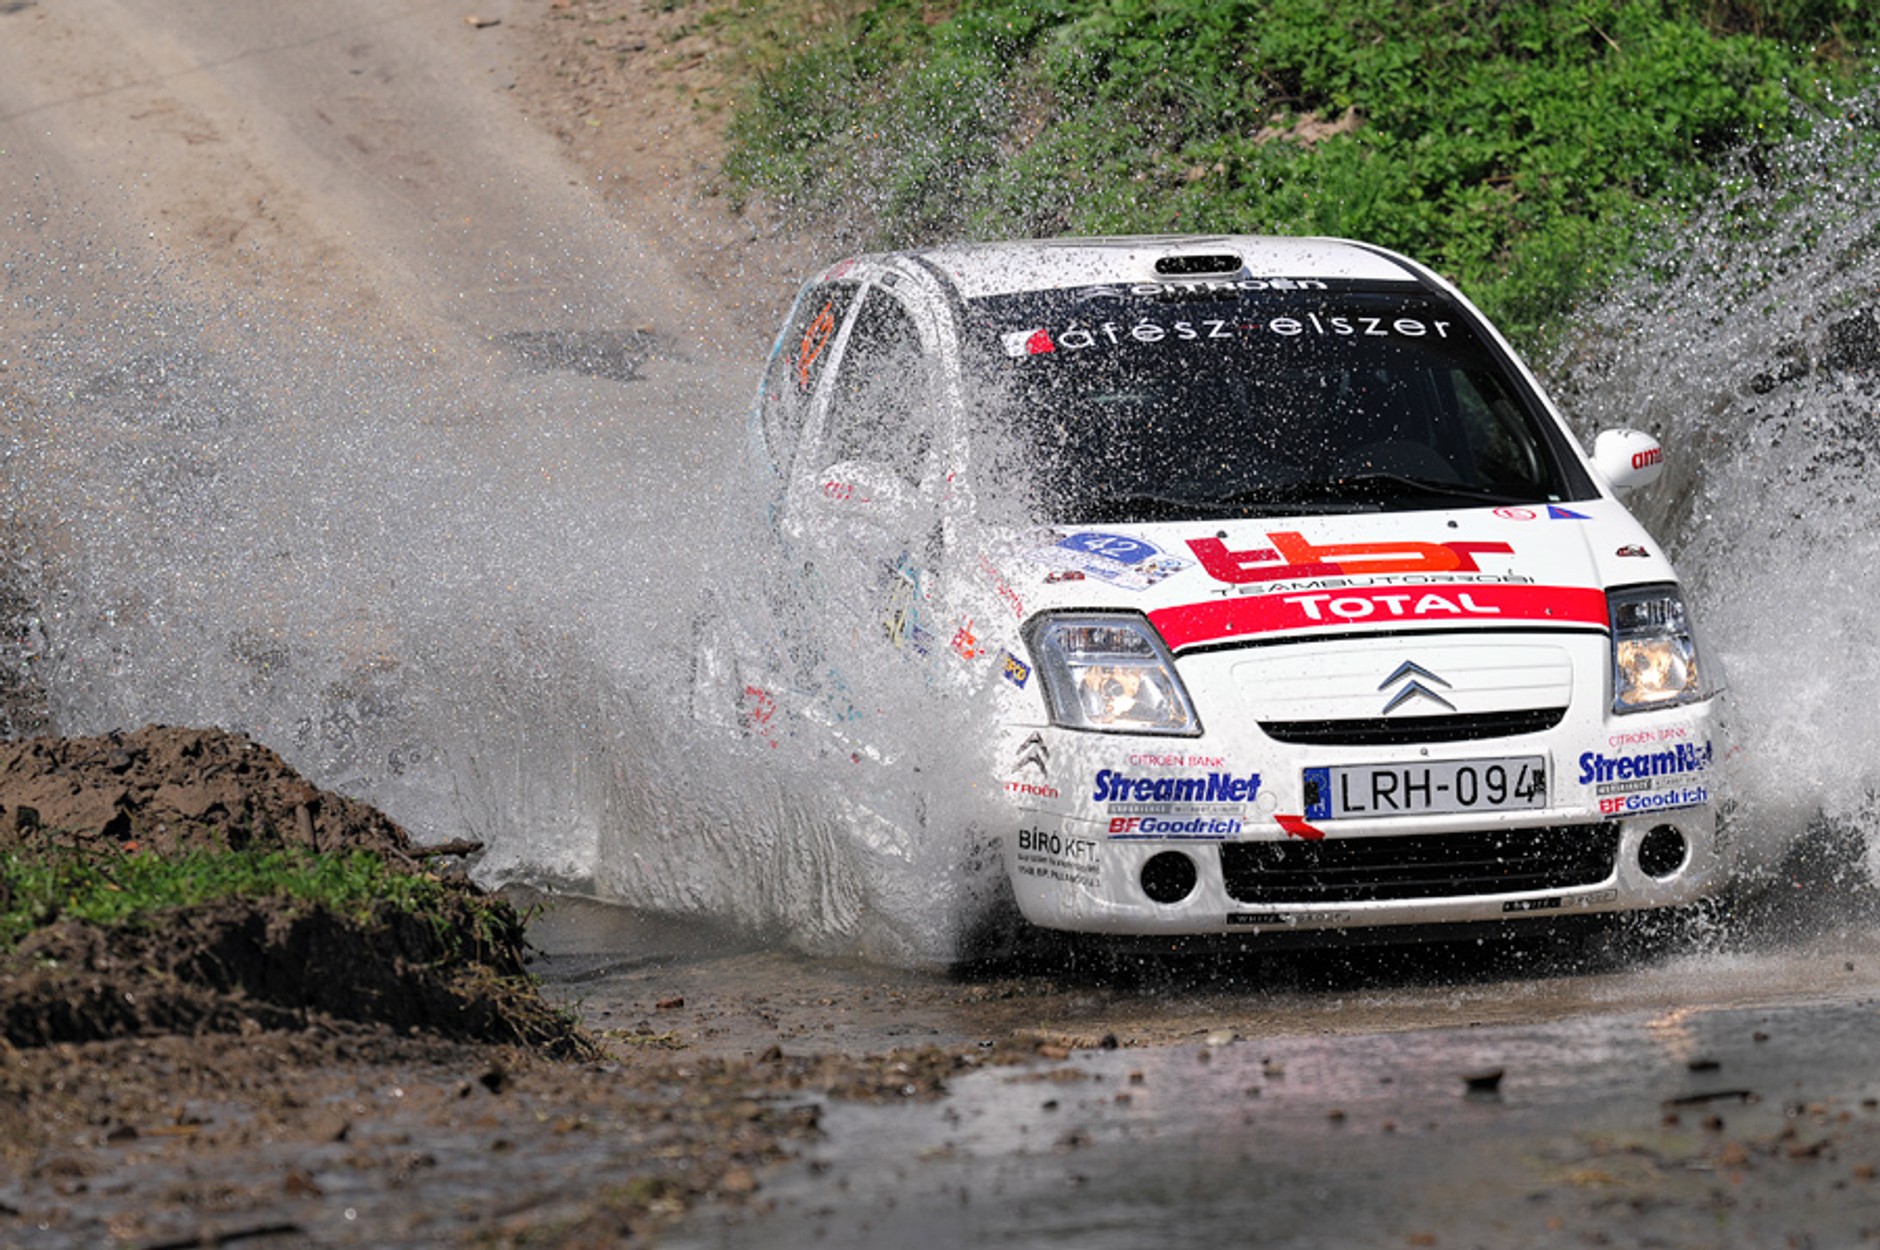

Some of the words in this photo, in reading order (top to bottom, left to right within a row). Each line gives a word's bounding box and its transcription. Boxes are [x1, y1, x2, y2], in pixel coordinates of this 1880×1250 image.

[1084, 538, 1139, 558] 42
[1283, 593, 1500, 620] TOTAL
[1188, 755, 1224, 768] BANK
[1093, 769, 1262, 803] StreamNet
[1341, 763, 1537, 813] LRH-094
[1108, 816, 1243, 834] BFGoodrich
